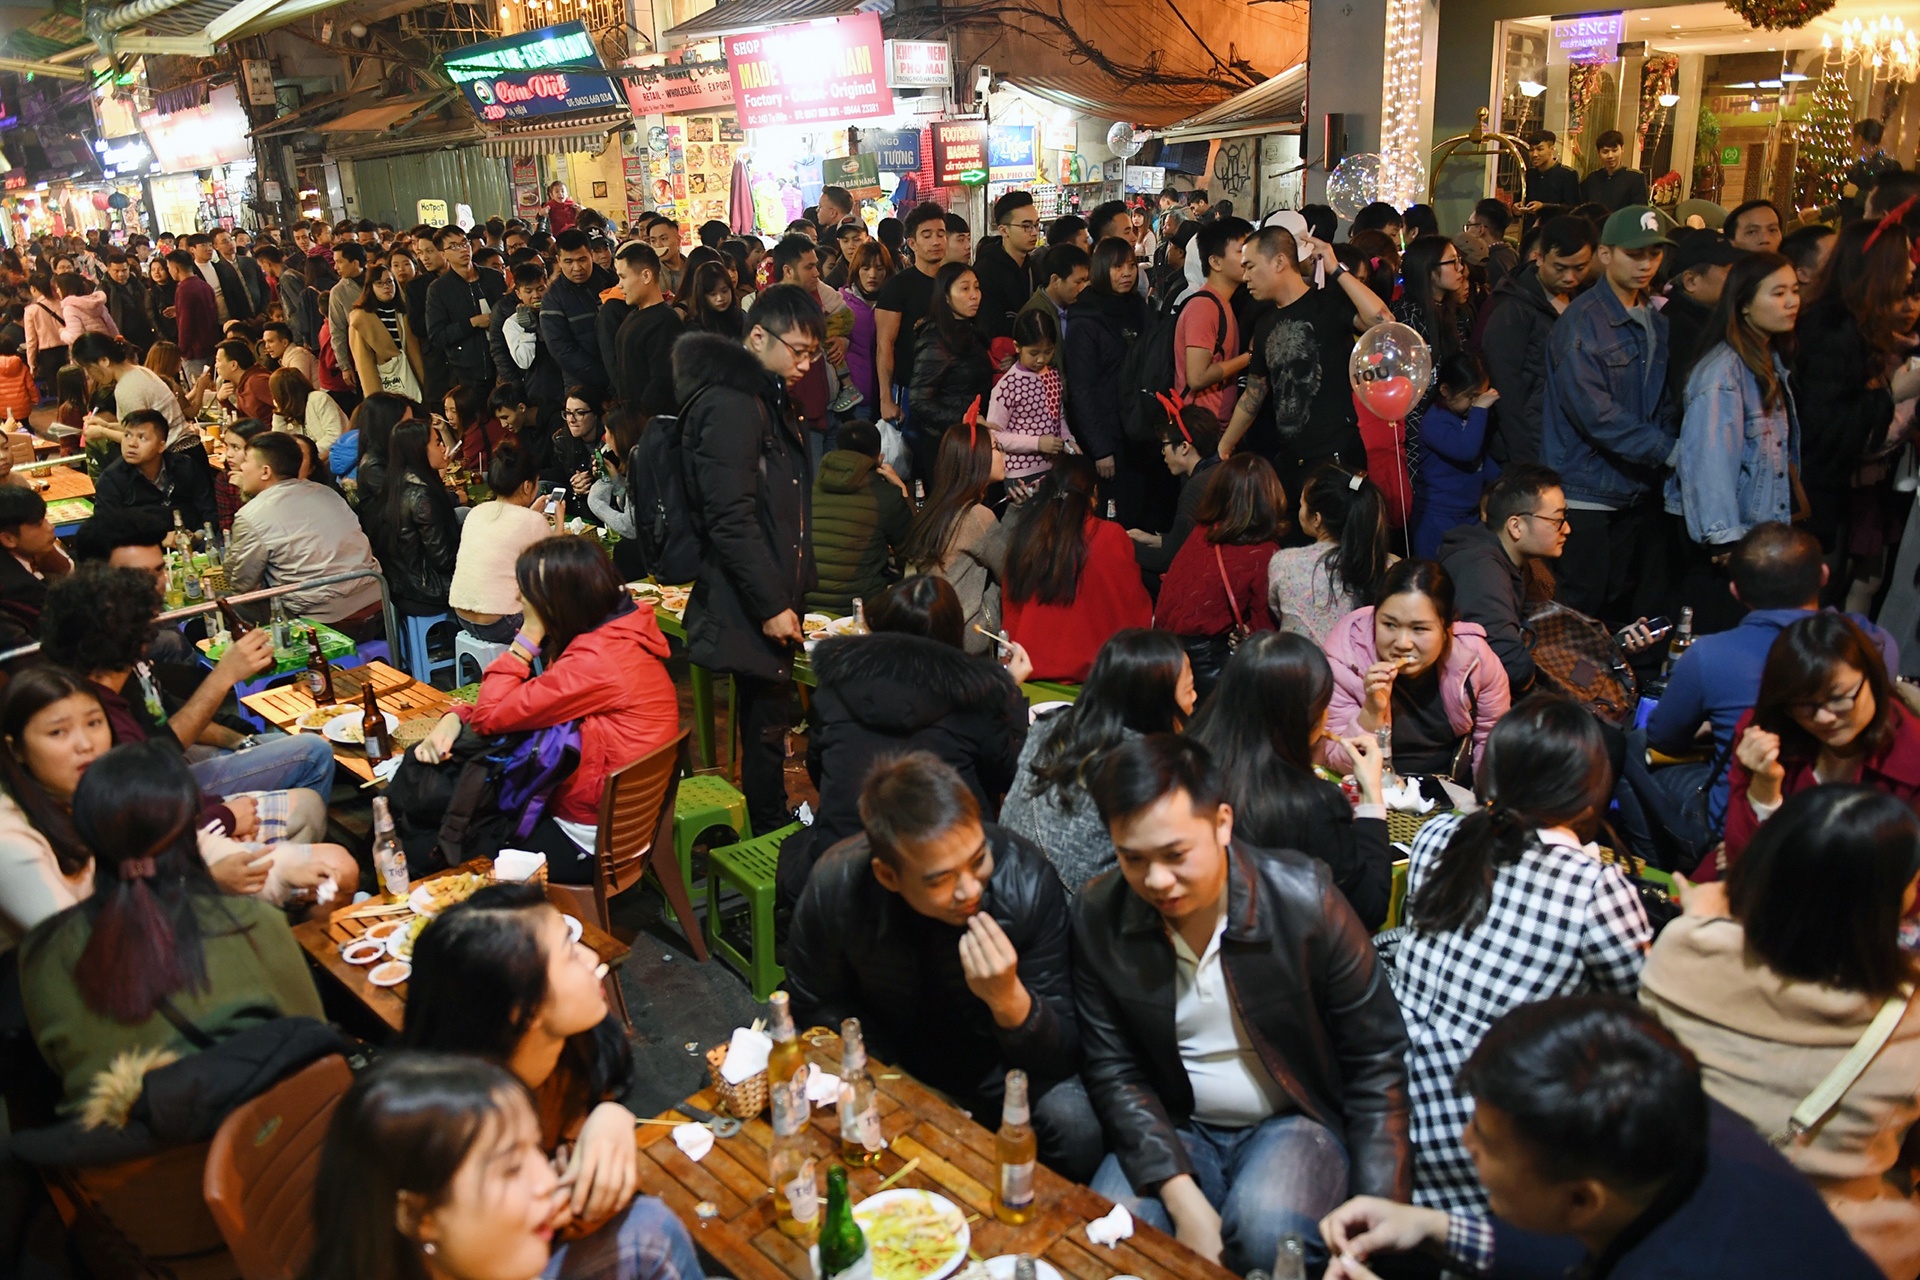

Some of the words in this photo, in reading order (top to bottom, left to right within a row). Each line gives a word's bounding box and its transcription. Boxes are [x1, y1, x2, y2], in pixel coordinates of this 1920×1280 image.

[1555, 19, 1617, 38] ESSENCE
[733, 39, 760, 56] SHOP
[1560, 37, 1609, 49] RESTAURANT
[738, 59, 780, 89] MADE
[925, 63, 945, 75] MAI
[642, 91, 662, 102] RETAIL
[666, 85, 703, 98] WHOLESALES
[708, 80, 732, 92] EXPORT
[744, 93, 783, 109] Factory
[830, 78, 877, 100] Original
[1000, 134, 1031, 163] Tiger
[990, 172, 1004, 181] BIA
[1353, 366, 1390, 386] YOU
